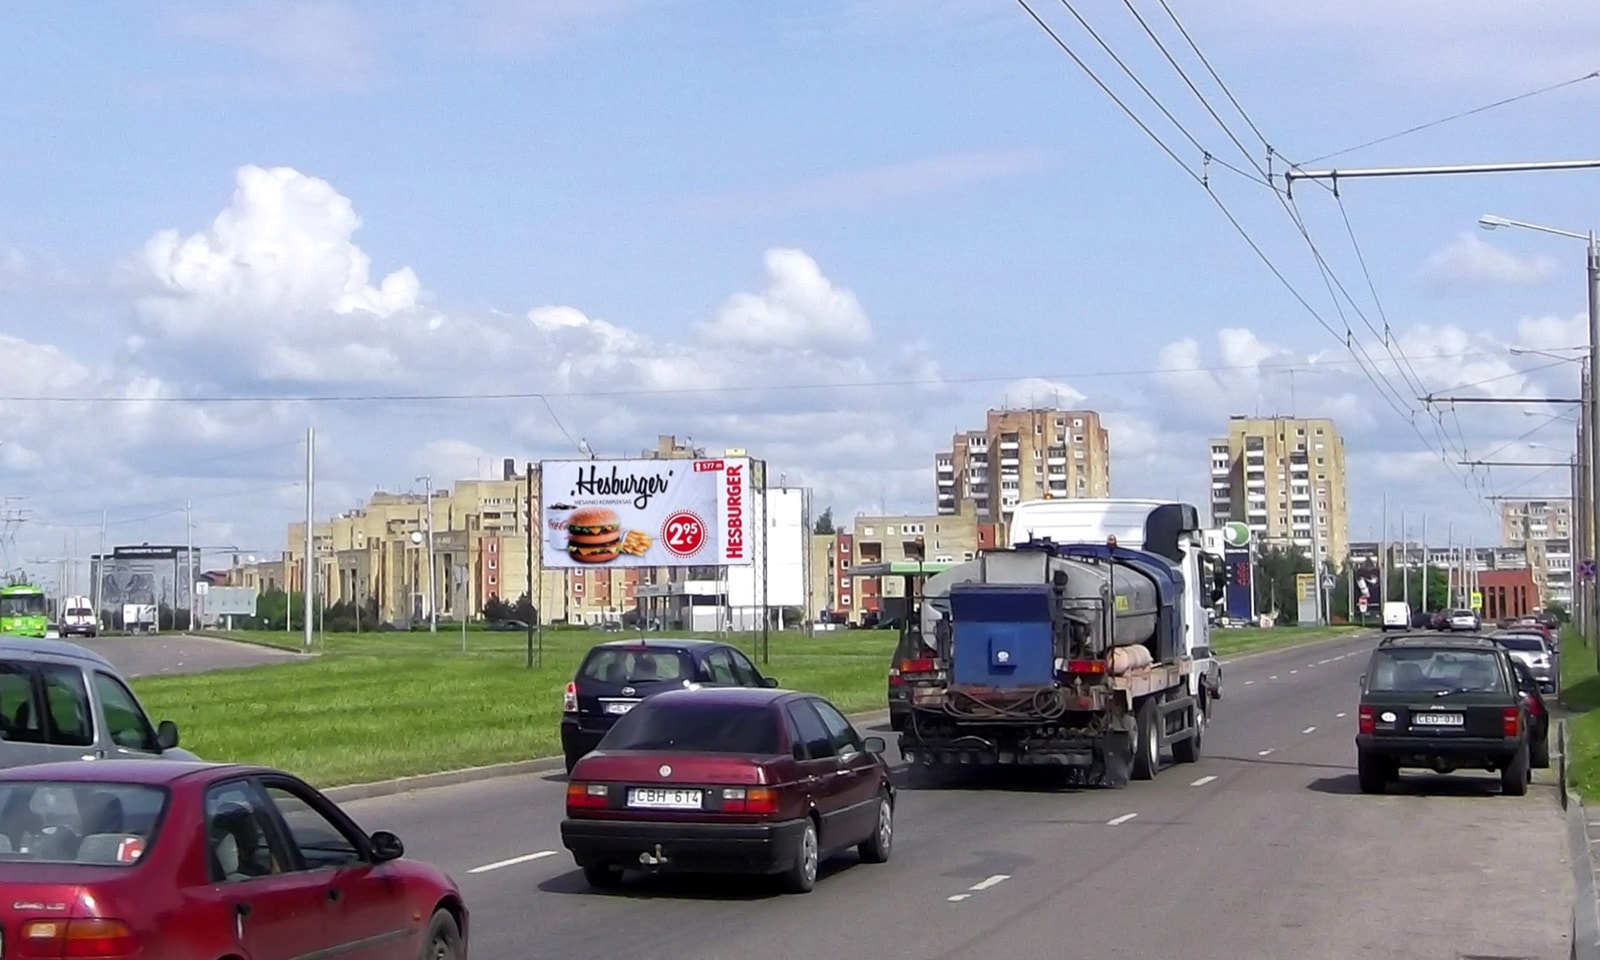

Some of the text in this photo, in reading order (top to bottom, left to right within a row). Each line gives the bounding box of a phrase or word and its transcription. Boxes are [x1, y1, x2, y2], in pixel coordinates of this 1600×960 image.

[726, 464, 743, 559] HESBURGER
[637, 789, 698, 803] CBH 614
